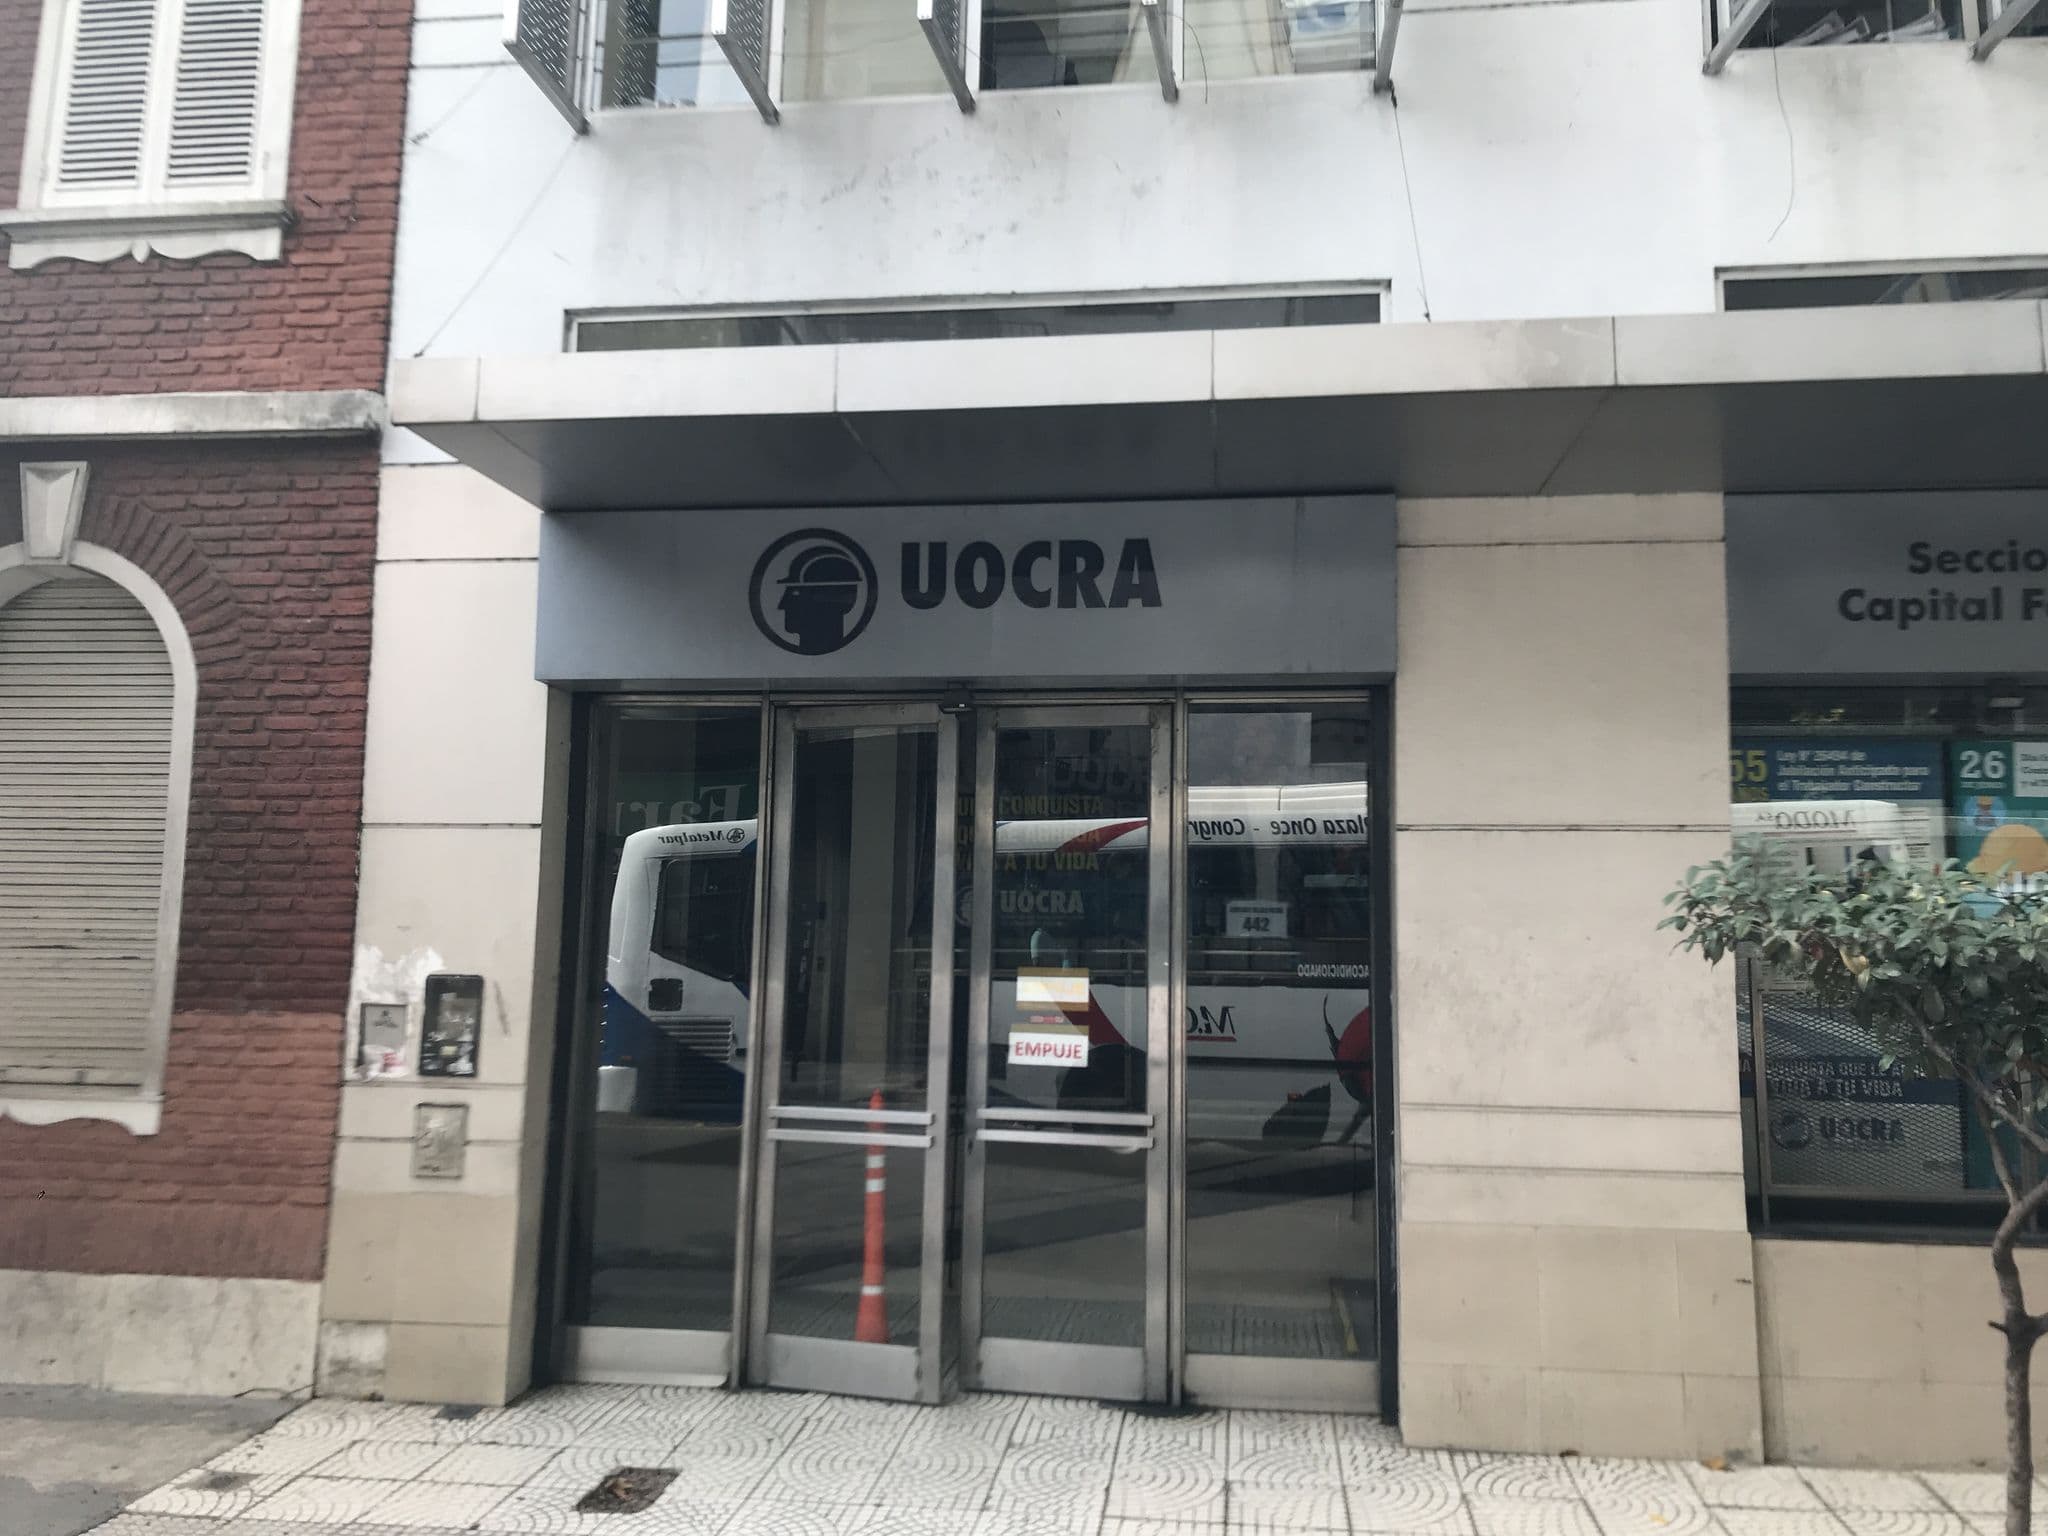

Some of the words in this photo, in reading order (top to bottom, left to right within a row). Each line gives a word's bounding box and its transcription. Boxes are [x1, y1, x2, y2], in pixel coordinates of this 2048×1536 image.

[901, 538, 1162, 610] UOCRA
[1838, 586, 2004, 631] Capital
[2020, 587, 2048, 621] F
[1960, 750, 2006, 779] 26
[998, 794, 1104, 817] CONQUISTA
[1053, 852, 1100, 872] VIDA
[999, 889, 1085, 914] UOCRA
[1242, 917, 1270, 933] 442
[1014, 1040, 1083, 1060] EMPUJE
[1820, 1118, 1904, 1142] UOCRA
